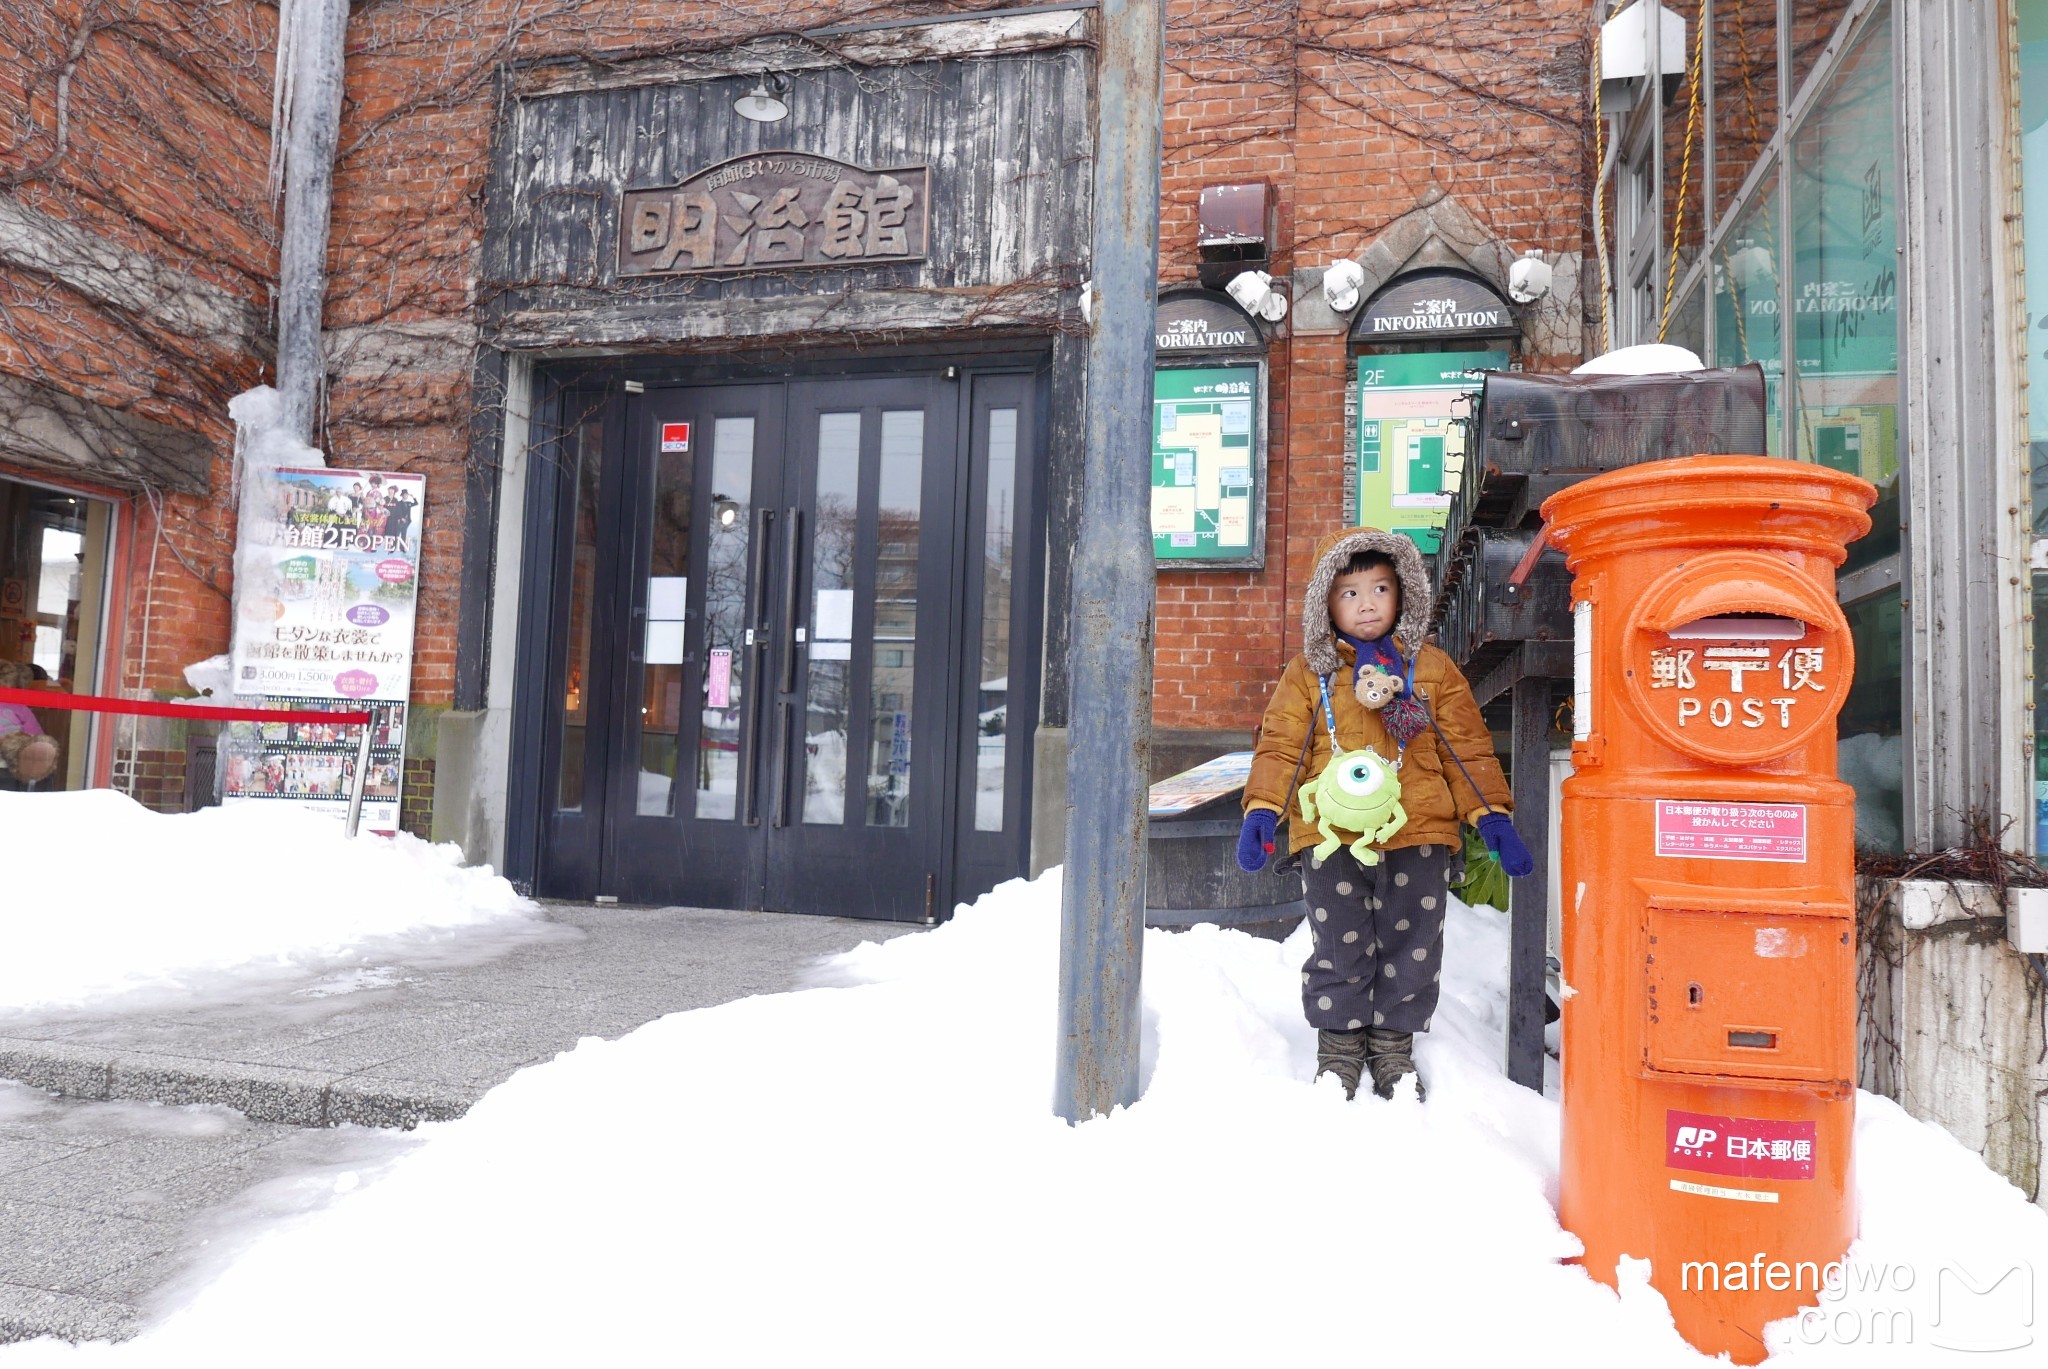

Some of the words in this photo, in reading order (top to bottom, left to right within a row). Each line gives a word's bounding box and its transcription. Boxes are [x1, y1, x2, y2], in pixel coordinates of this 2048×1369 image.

[706, 160, 842, 192] 函館はいから市場
[630, 174, 914, 270] 明治館
[1412, 299, 1457, 315] ご案内
[1167, 319, 1208, 334] ご案内
[1373, 311, 1499, 332] INFORMATION
[1364, 370, 1385, 385] 2F
[1677, 696, 1797, 729] POST
[1665, 805, 1799, 819] 日本郵便が取り扱う次のもののみ
[1691, 817, 1775, 829] 投かんしてください
[1673, 1146, 1714, 1158] POST
[1727, 1136, 1811, 1161] 日本郵便
